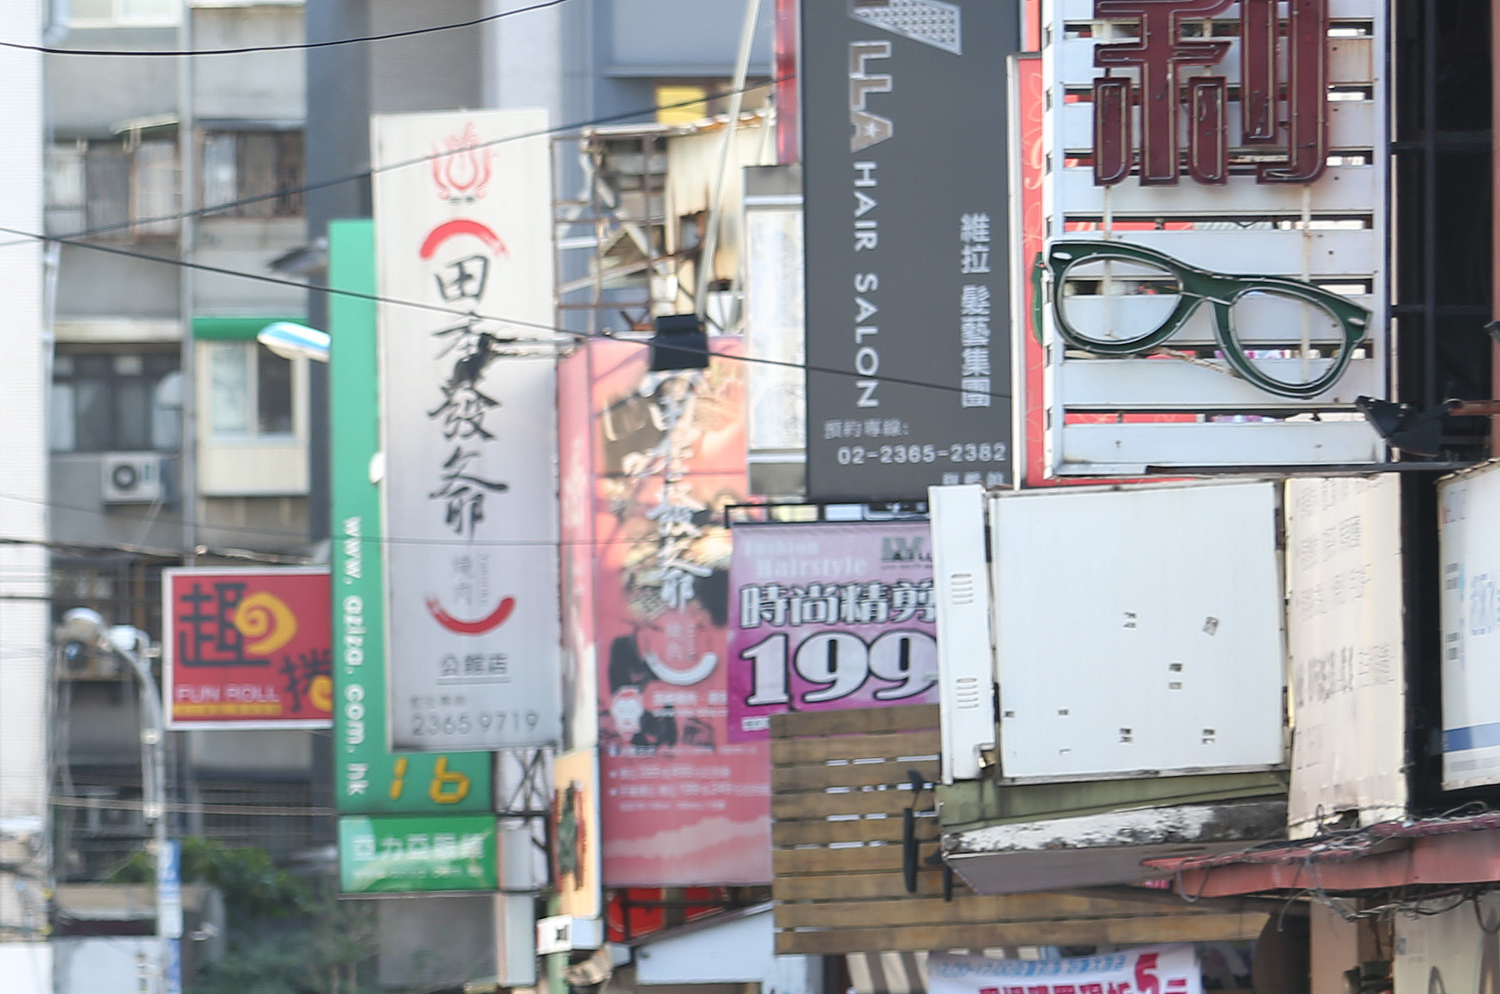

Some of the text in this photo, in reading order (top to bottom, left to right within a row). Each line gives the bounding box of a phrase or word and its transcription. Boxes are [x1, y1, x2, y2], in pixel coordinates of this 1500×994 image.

[853, 161, 878, 251] HAIR
[854, 272, 880, 408] SALON
[836, 442, 1007, 466] 02-2365-2382
[740, 629, 938, 706] 199
[478, 710, 539, 733] 9719
